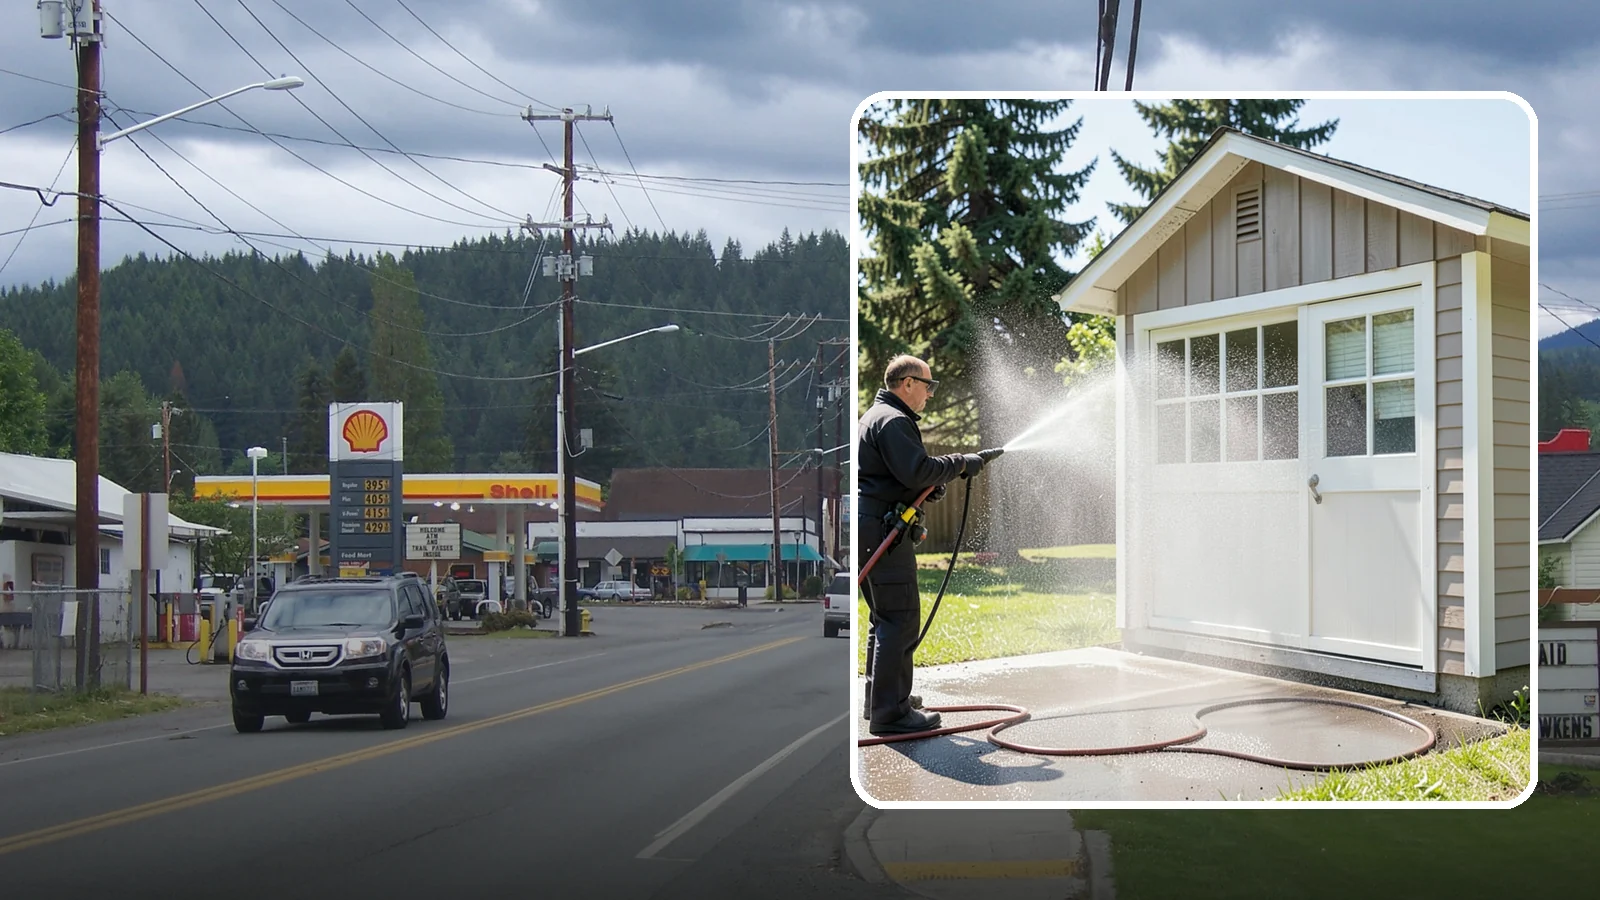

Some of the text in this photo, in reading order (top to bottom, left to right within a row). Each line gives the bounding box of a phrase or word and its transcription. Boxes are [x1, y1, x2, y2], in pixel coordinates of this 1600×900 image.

[366, 480, 383, 490] 395
[490, 484, 547, 499] Shell
[366, 494, 383, 504] 405
[366, 508, 383, 518] 415
[366, 522, 383, 532] 429
